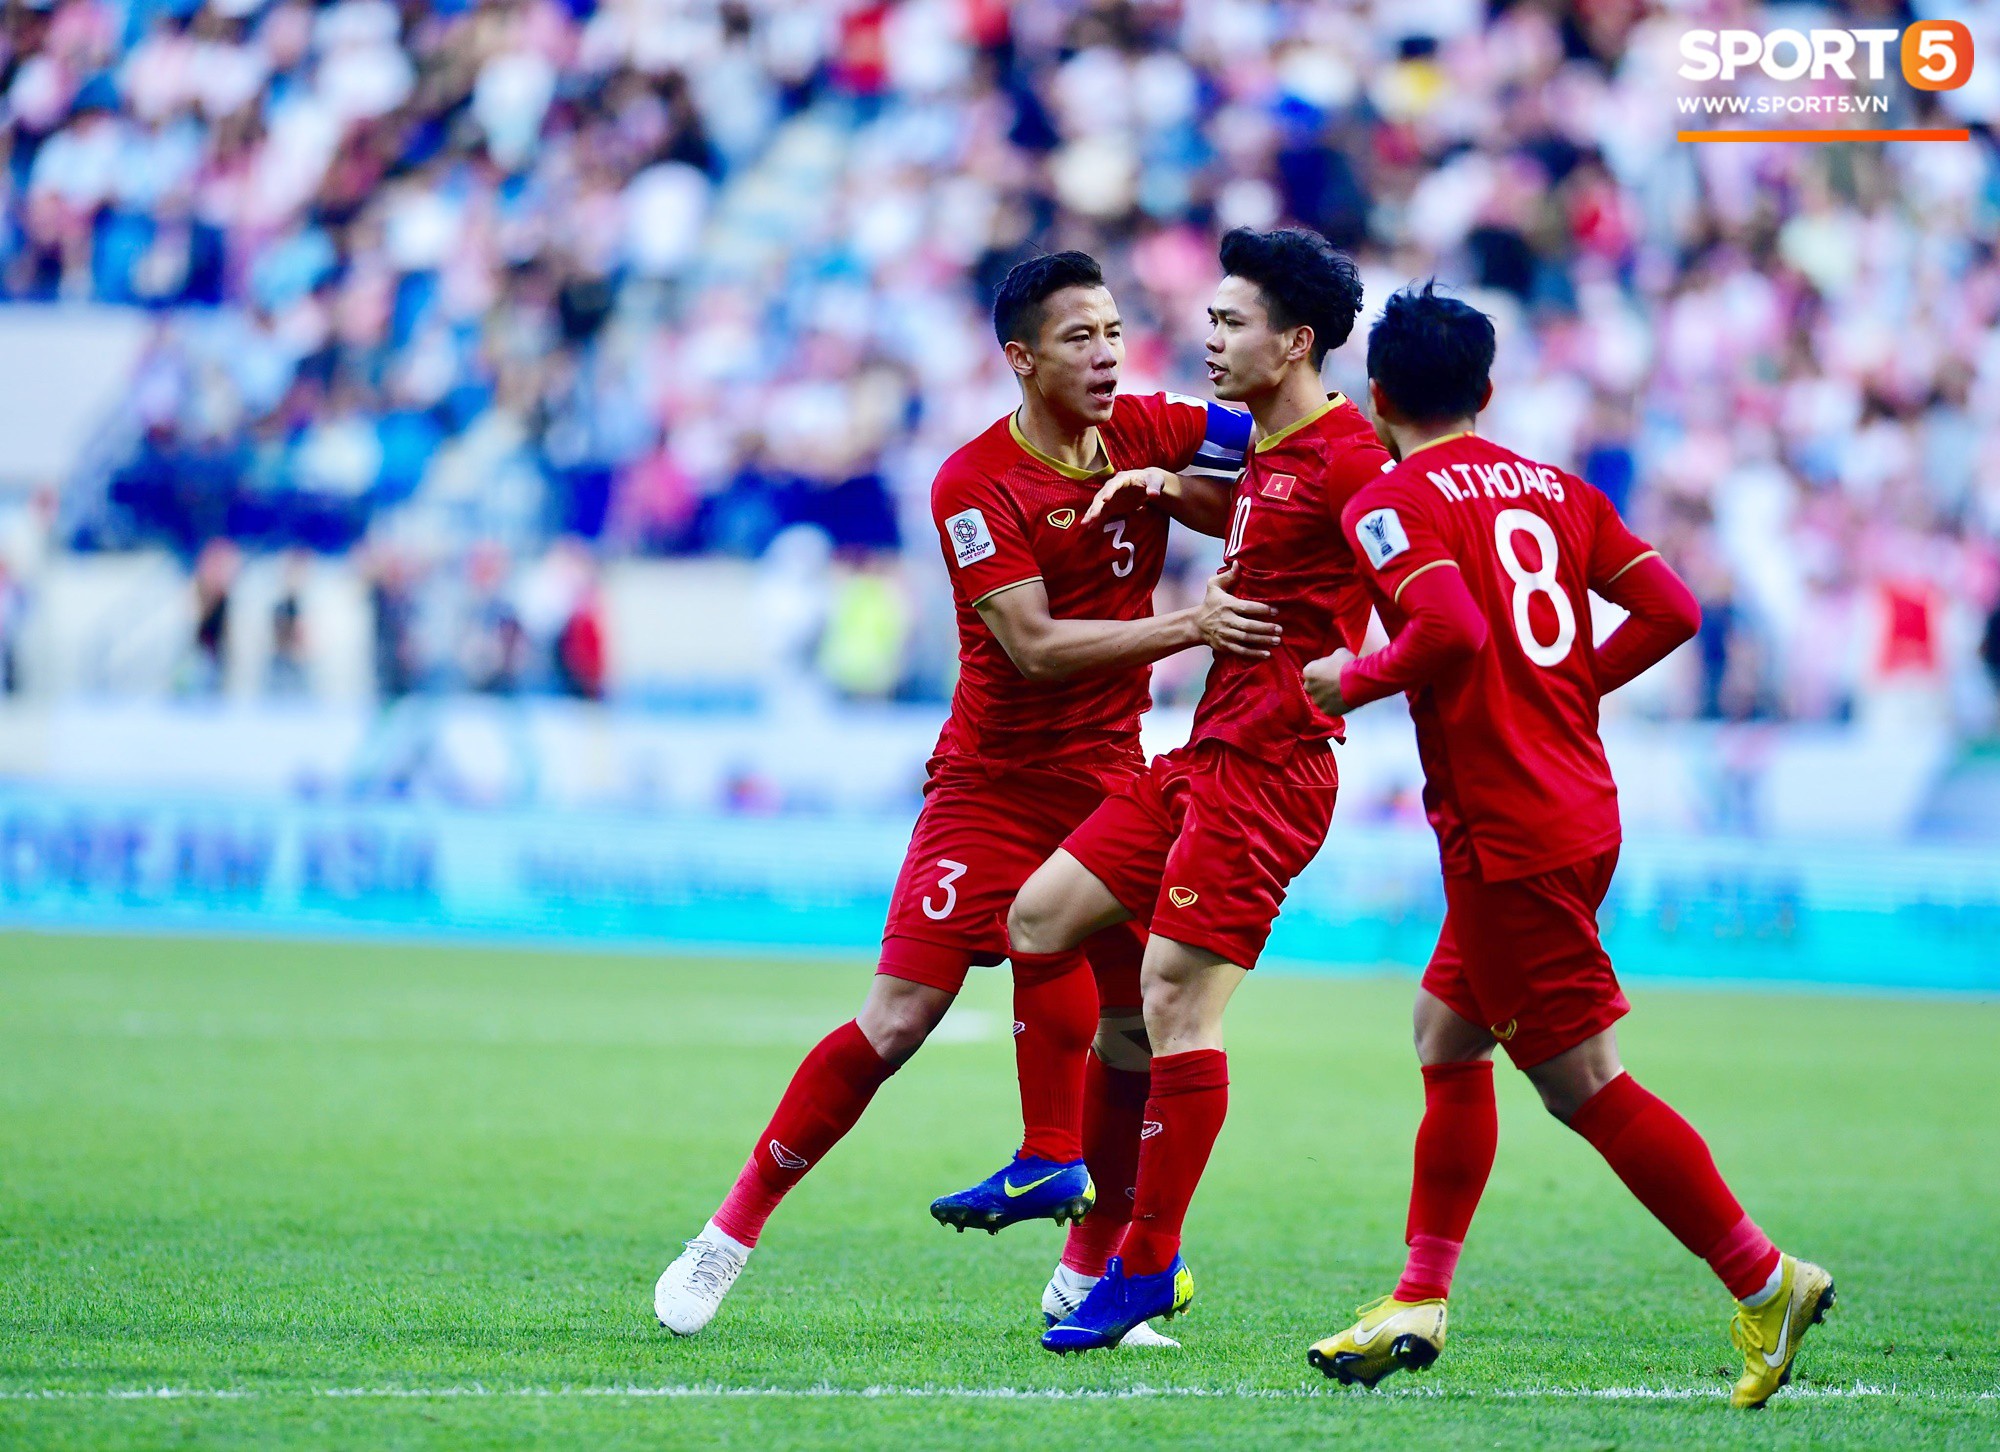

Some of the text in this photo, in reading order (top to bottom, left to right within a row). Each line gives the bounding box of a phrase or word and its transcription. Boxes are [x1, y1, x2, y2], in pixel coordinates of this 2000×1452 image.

[976, 541, 990, 551] CUP
[1103, 520, 1135, 578] 3
[1225, 495, 1252, 557] 10
[1495, 508, 1577, 667] 8
[922, 859, 967, 920] 3
